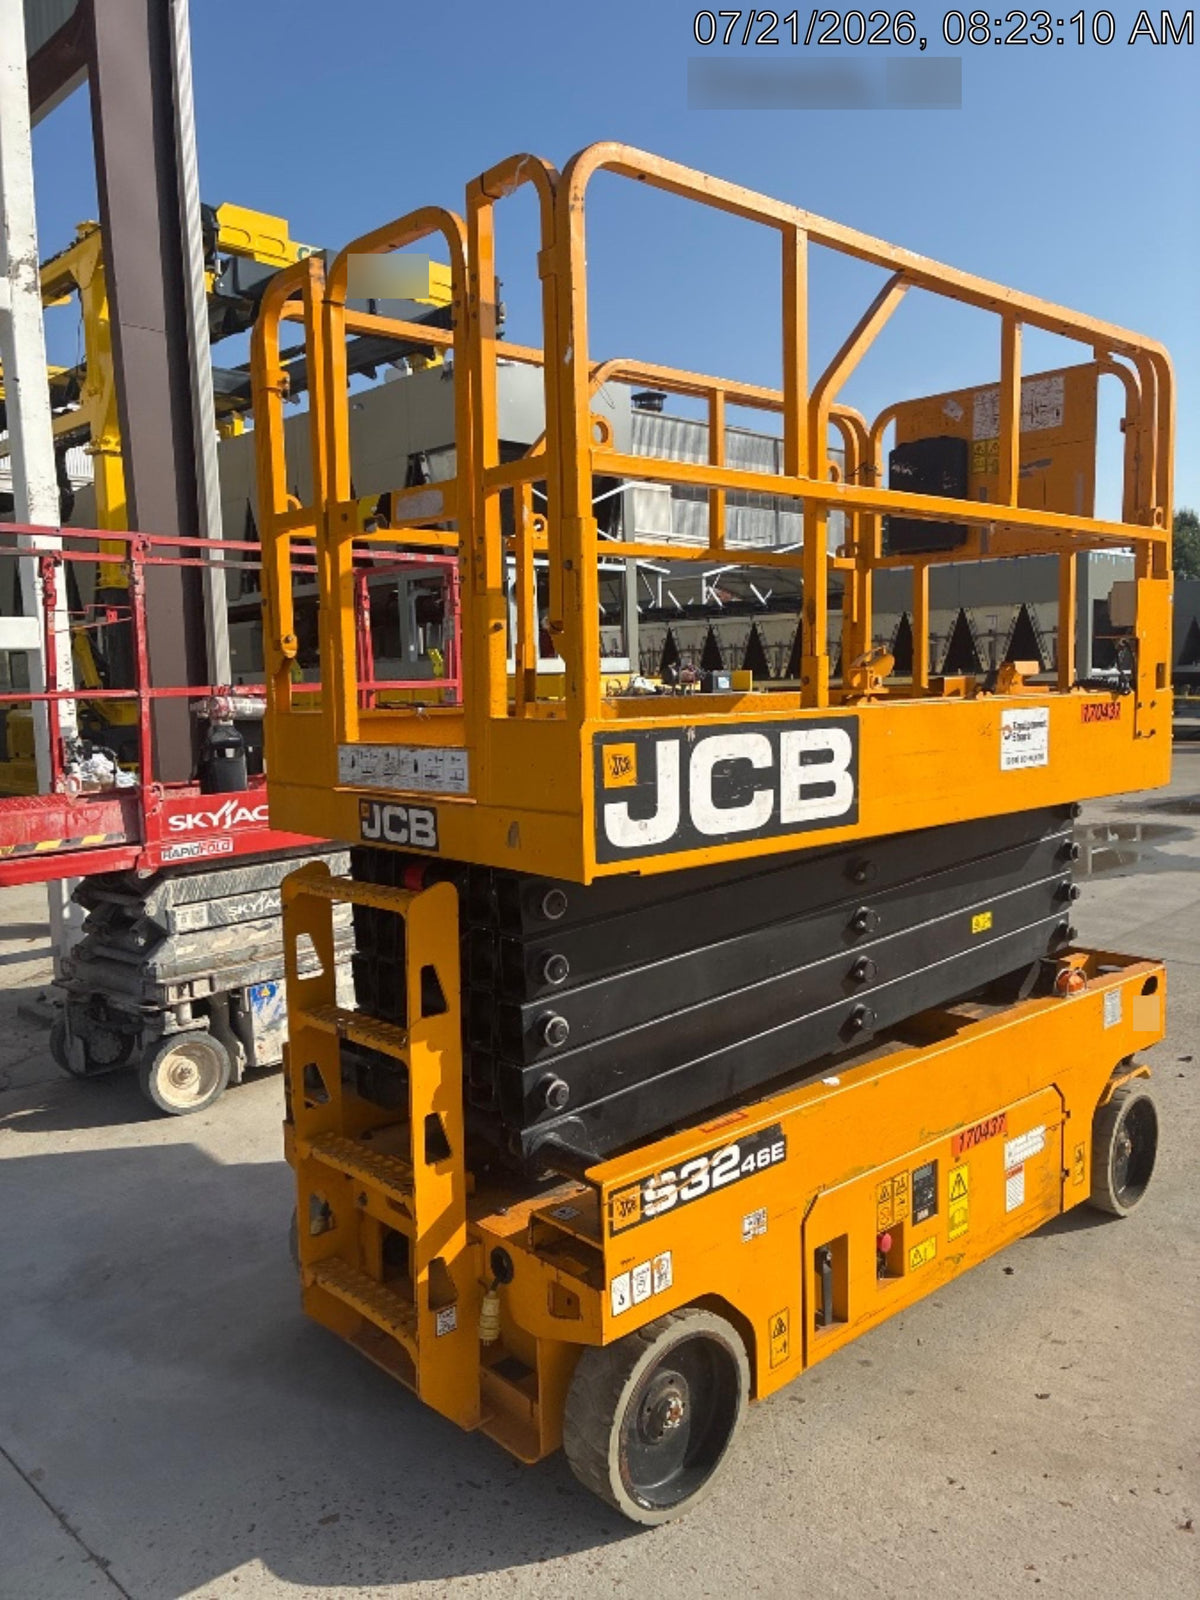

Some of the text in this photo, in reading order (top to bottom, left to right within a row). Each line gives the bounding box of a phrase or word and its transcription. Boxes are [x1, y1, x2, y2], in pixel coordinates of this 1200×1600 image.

[604, 728, 853, 847] JCB
[168, 799, 269, 832] SKYJAC
[362, 803, 437, 847] JCB
[959, 1112, 1006, 1154] 170437
